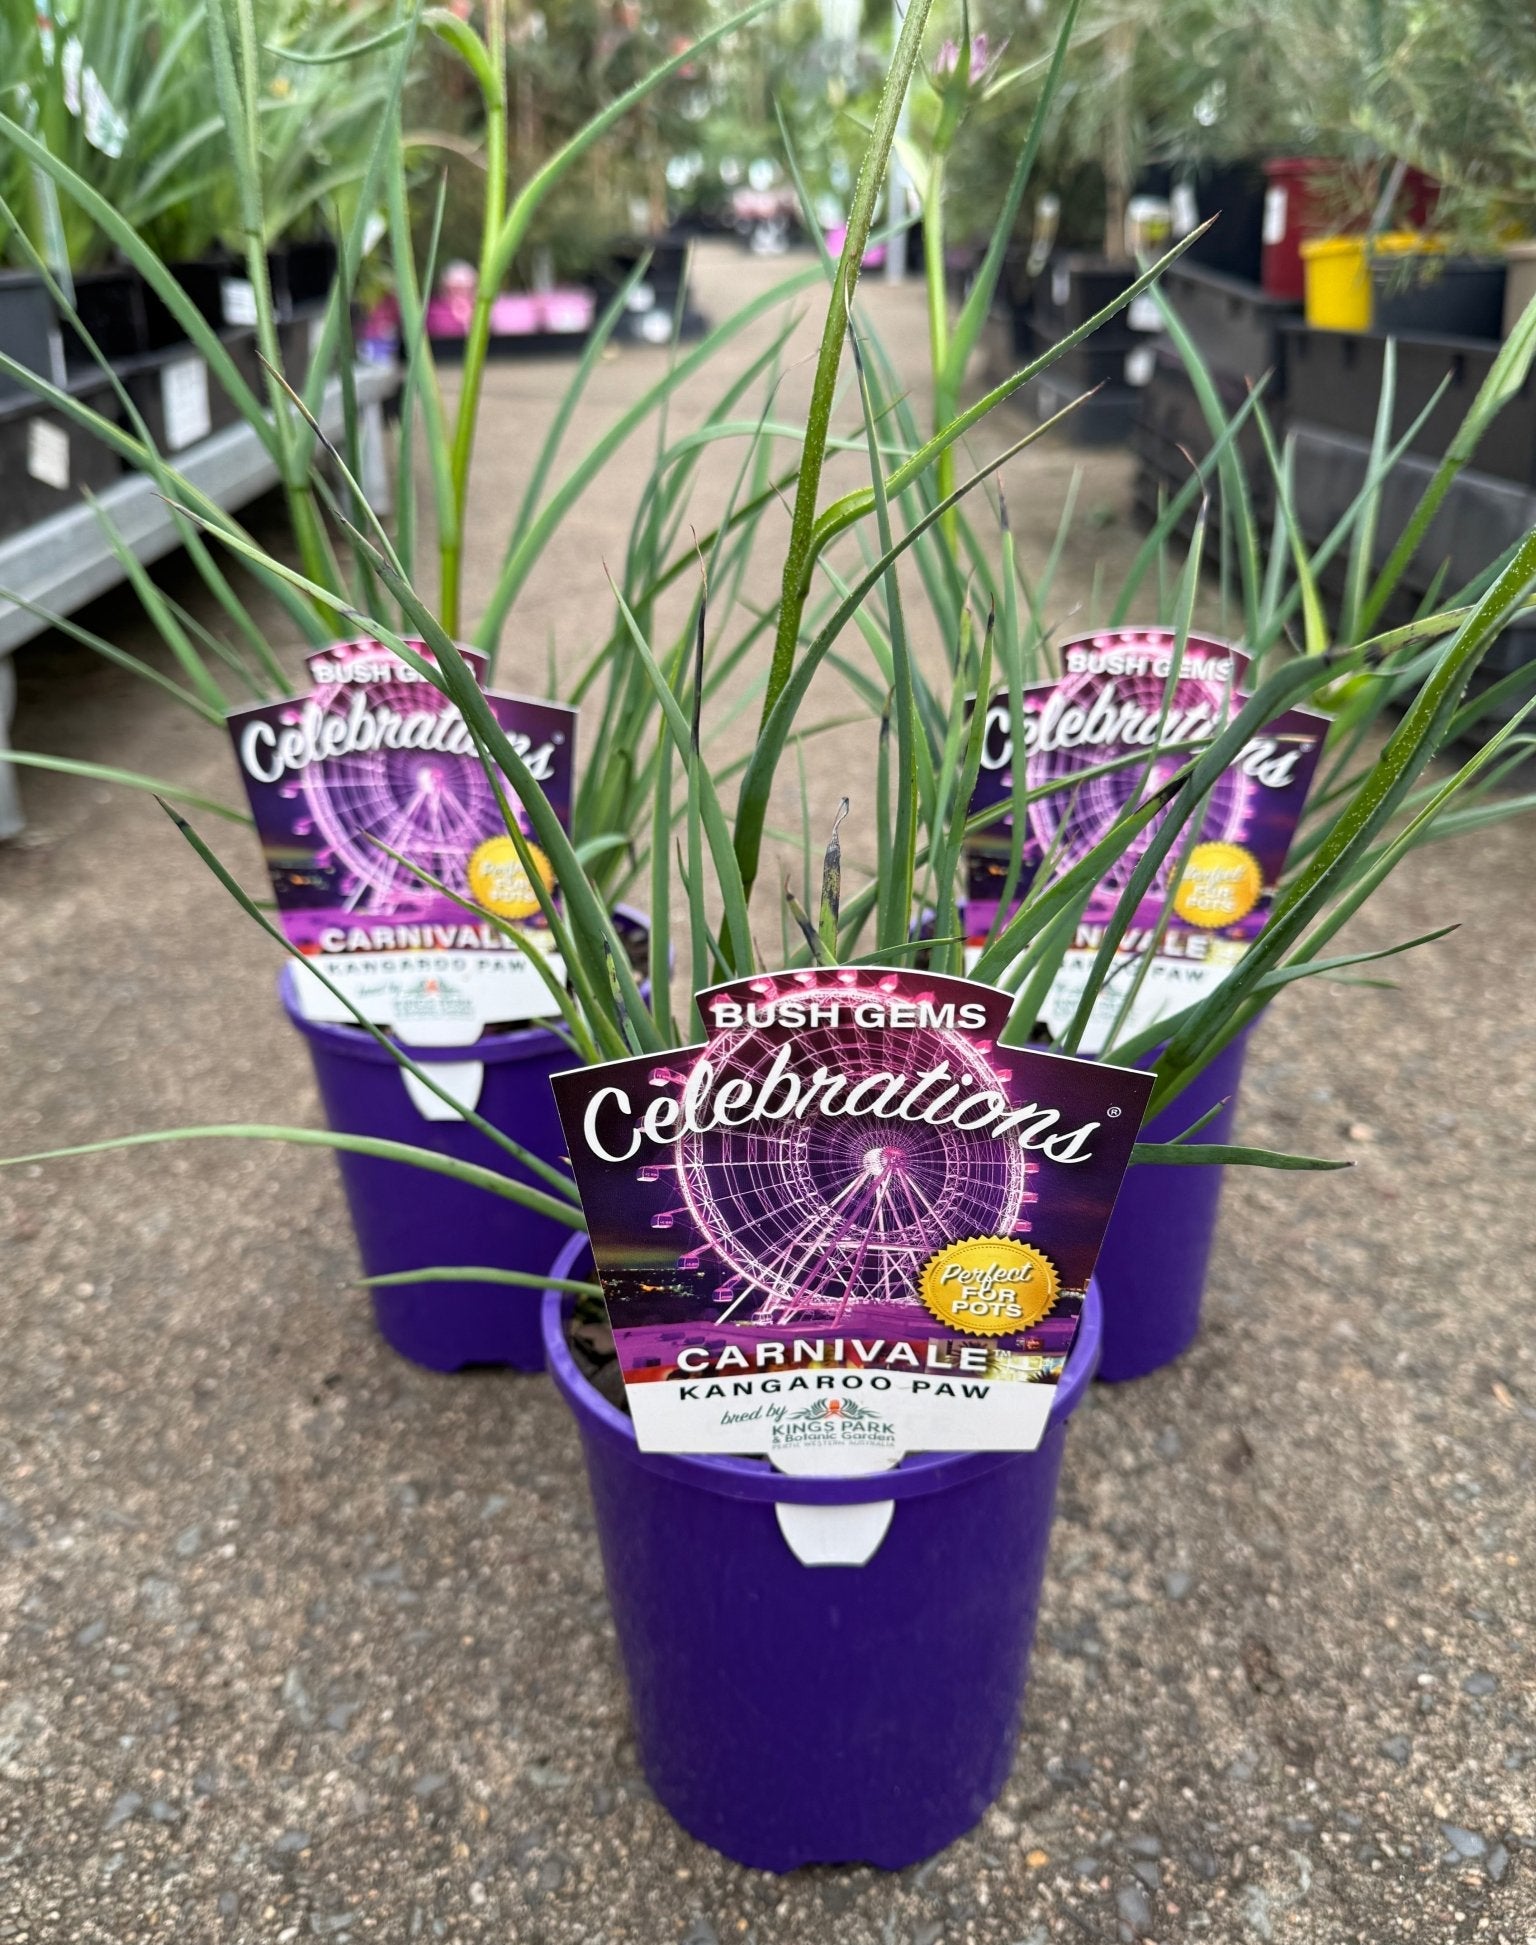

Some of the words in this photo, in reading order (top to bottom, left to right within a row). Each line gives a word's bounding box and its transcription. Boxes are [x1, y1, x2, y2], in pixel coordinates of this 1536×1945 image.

[313, 662, 391, 684] BUSH
[1067, 653, 1147, 676] BUSH
[1152, 658, 1235, 682] GEMS
[242, 690, 555, 782] Celebratins
[979, 682, 1298, 788] Celebratins
[714, 1002, 840, 1028] BUSH
[854, 1003, 987, 1029] GEMS
[583, 1042, 1101, 1163] Celebrations
[940, 1261, 1033, 1292] Perfect
[961, 1286, 1017, 1302] FOR
[951, 1300, 1023, 1318] POTS
[677, 1338, 988, 1373] CARNIVALE
[679, 1374, 892, 1401] KANGAROO
[911, 1379, 991, 1400] PAW
[720, 1404, 763, 1425] bred
[766, 1402, 789, 1423] by
[772, 1421, 834, 1436] KINGS
[841, 1421, 895, 1434] PARK
[785, 1432, 836, 1443] Botanic
[841, 1432, 895, 1442] Garden
